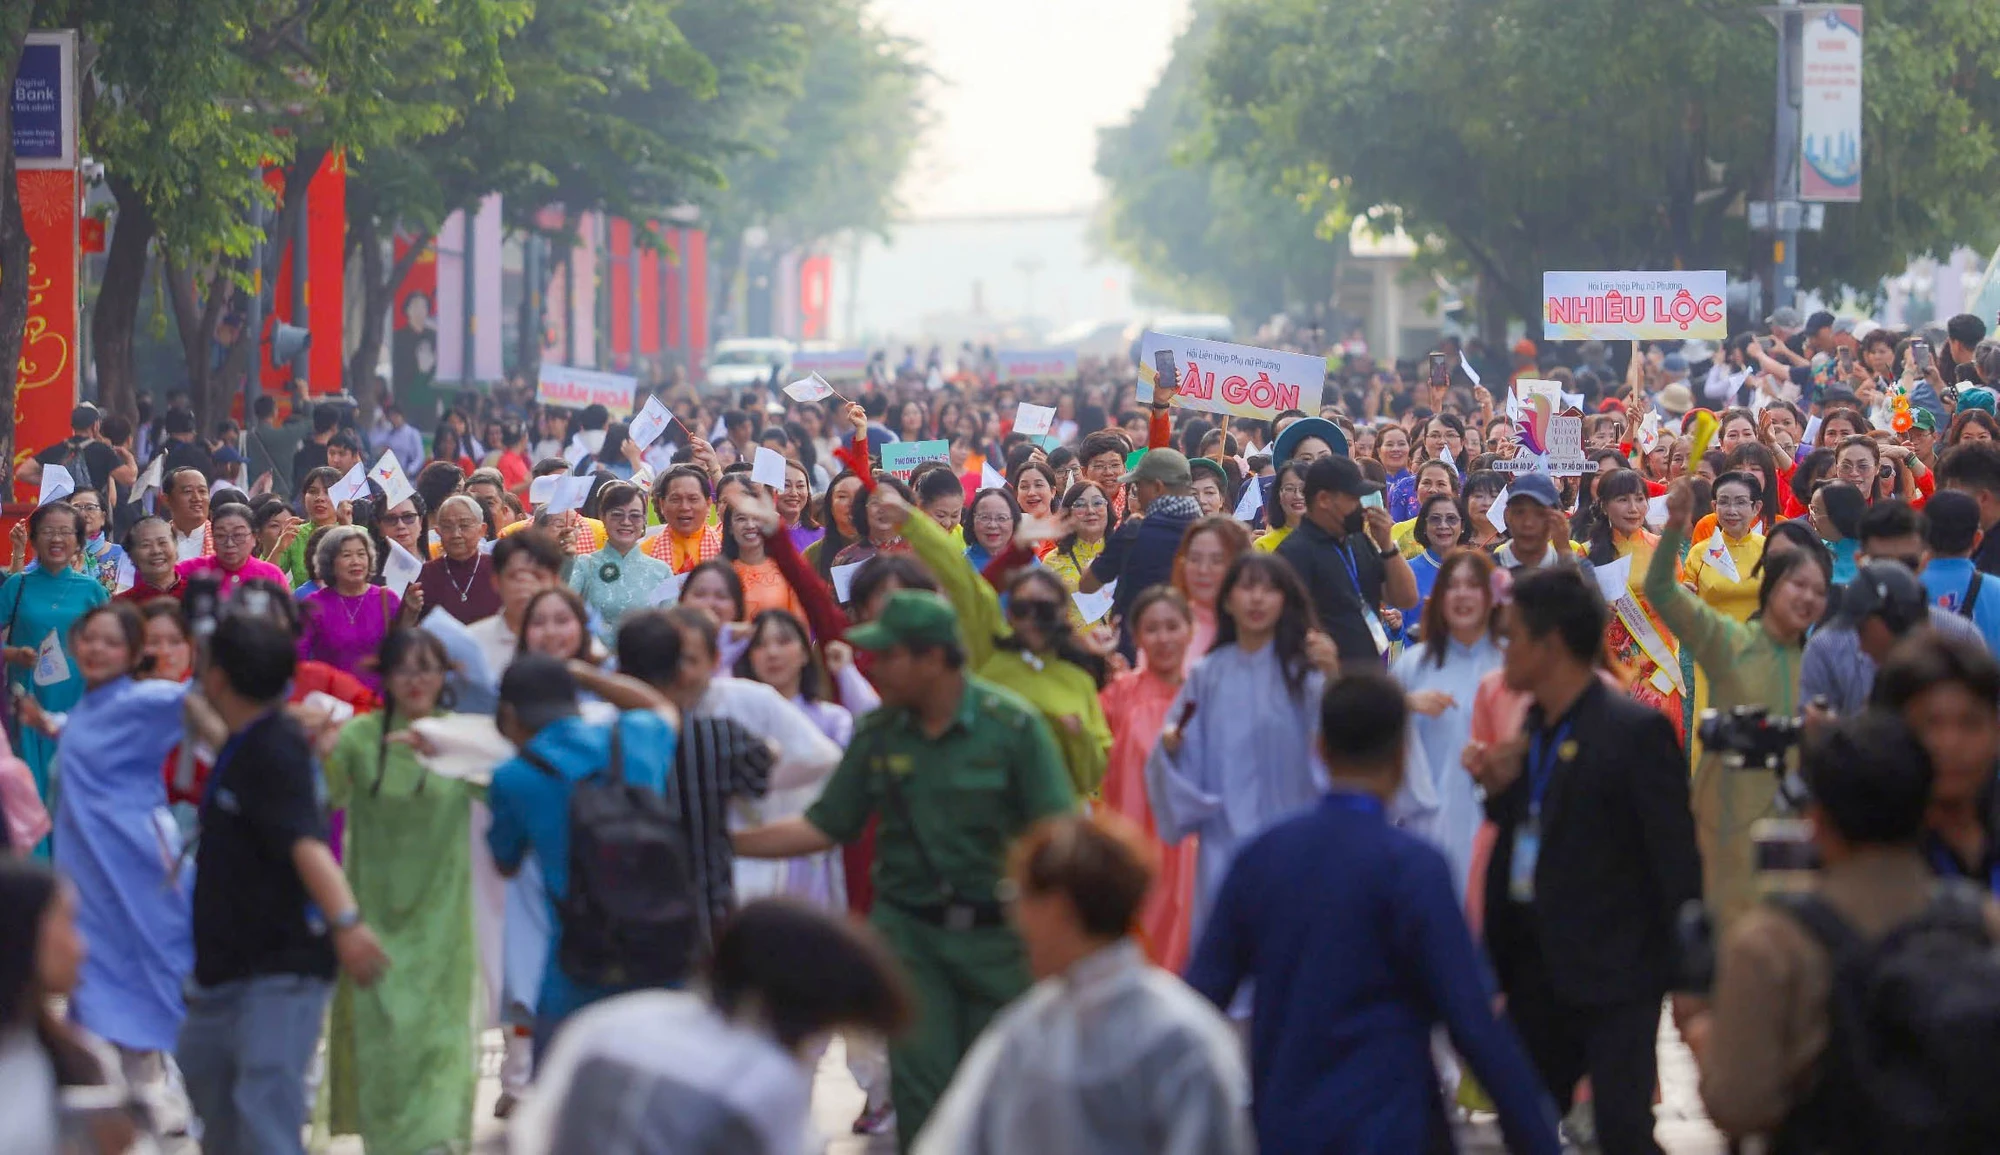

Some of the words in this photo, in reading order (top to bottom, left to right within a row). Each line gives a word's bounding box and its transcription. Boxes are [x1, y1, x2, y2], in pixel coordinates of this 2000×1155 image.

[15, 86, 54, 101] Bank
[1549, 290, 1645, 324] NHIÊU
[1653, 289, 1723, 331] LỘC
[1178, 361, 1215, 400] ÀI
[1221, 371, 1300, 411] GÒN
[1493, 462, 1503, 470] CLB
